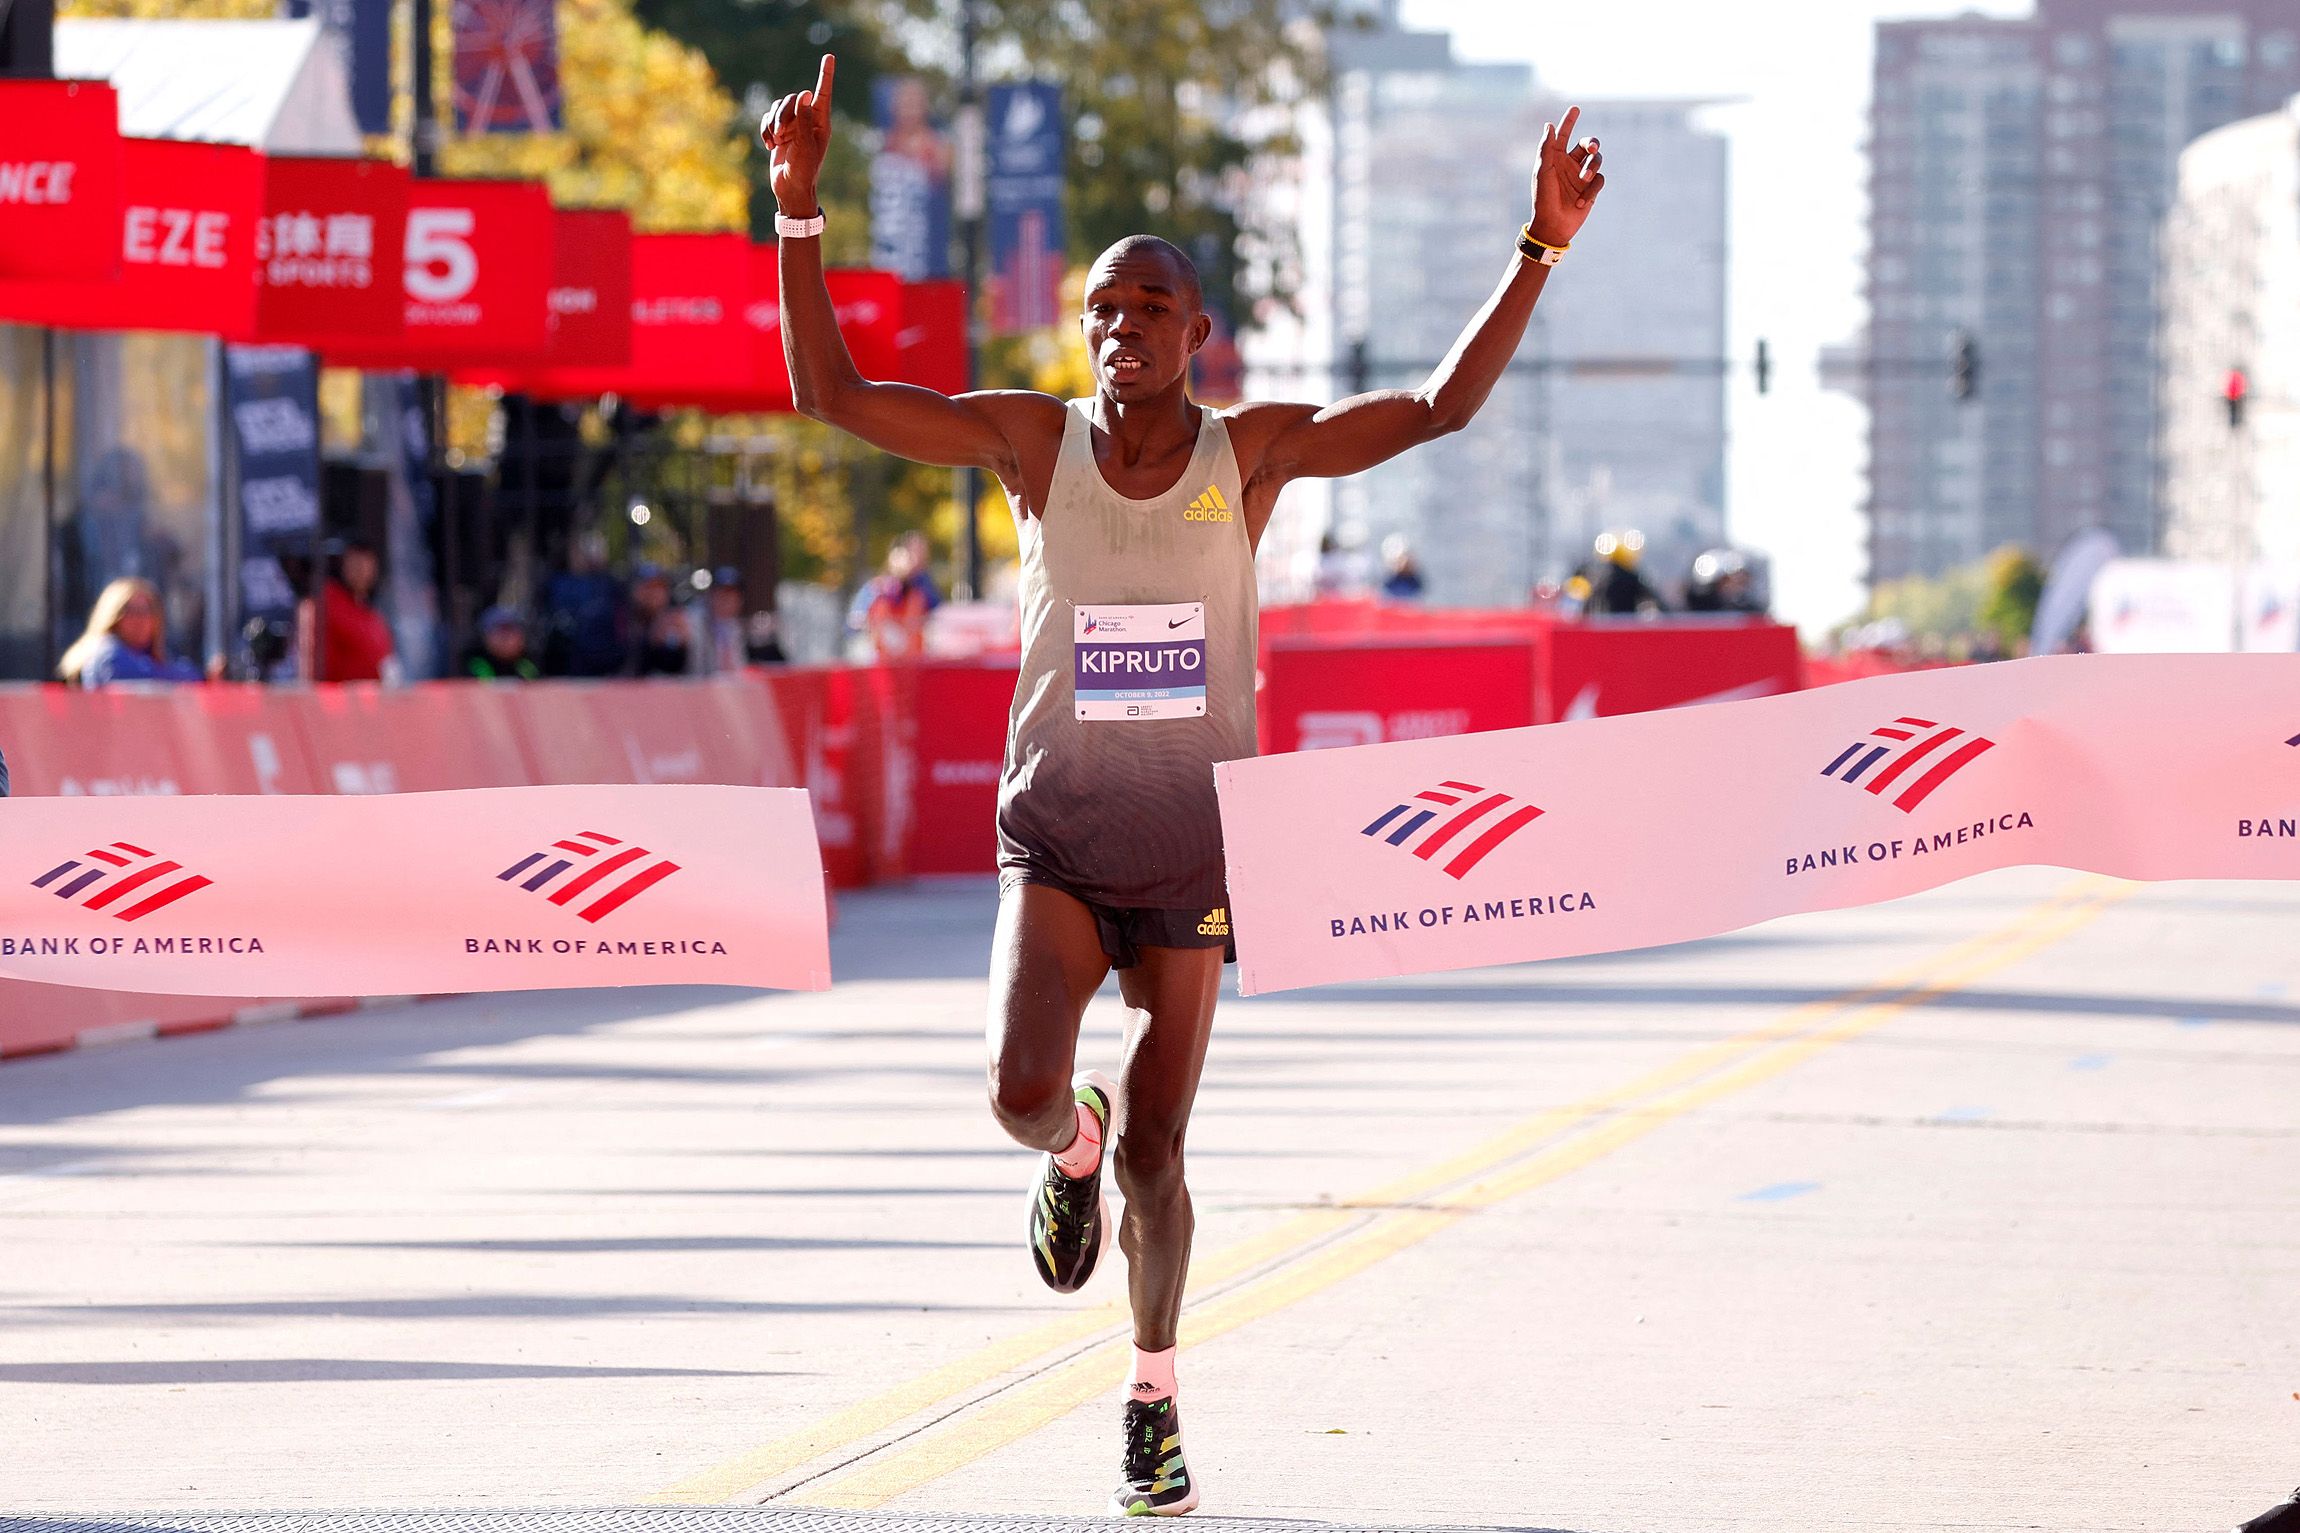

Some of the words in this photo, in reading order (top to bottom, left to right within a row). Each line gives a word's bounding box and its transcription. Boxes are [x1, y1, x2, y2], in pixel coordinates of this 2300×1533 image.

[122, 205, 230, 269] EZE
[403, 207, 478, 303] 5
[1183, 508, 1233, 522] adidas
[1098, 620, 1121, 628] Chicago
[1081, 647, 1201, 673] KIPRUTO
[1786, 845, 1859, 876] BANK
[1867, 840, 1903, 861] OF
[1913, 812, 2034, 856] AMERICA
[1330, 911, 1410, 938] BANK
[1418, 906, 1454, 927] OF
[1463, 892, 1596, 923] AMERICA
[2, 937, 80, 956] BANK
[90, 937, 124, 955] OF
[133, 937, 264, 954] AMERICA
[465, 938, 543, 953] BANK
[553, 939, 587, 954] OF
[596, 940, 727, 955] AMERICA
